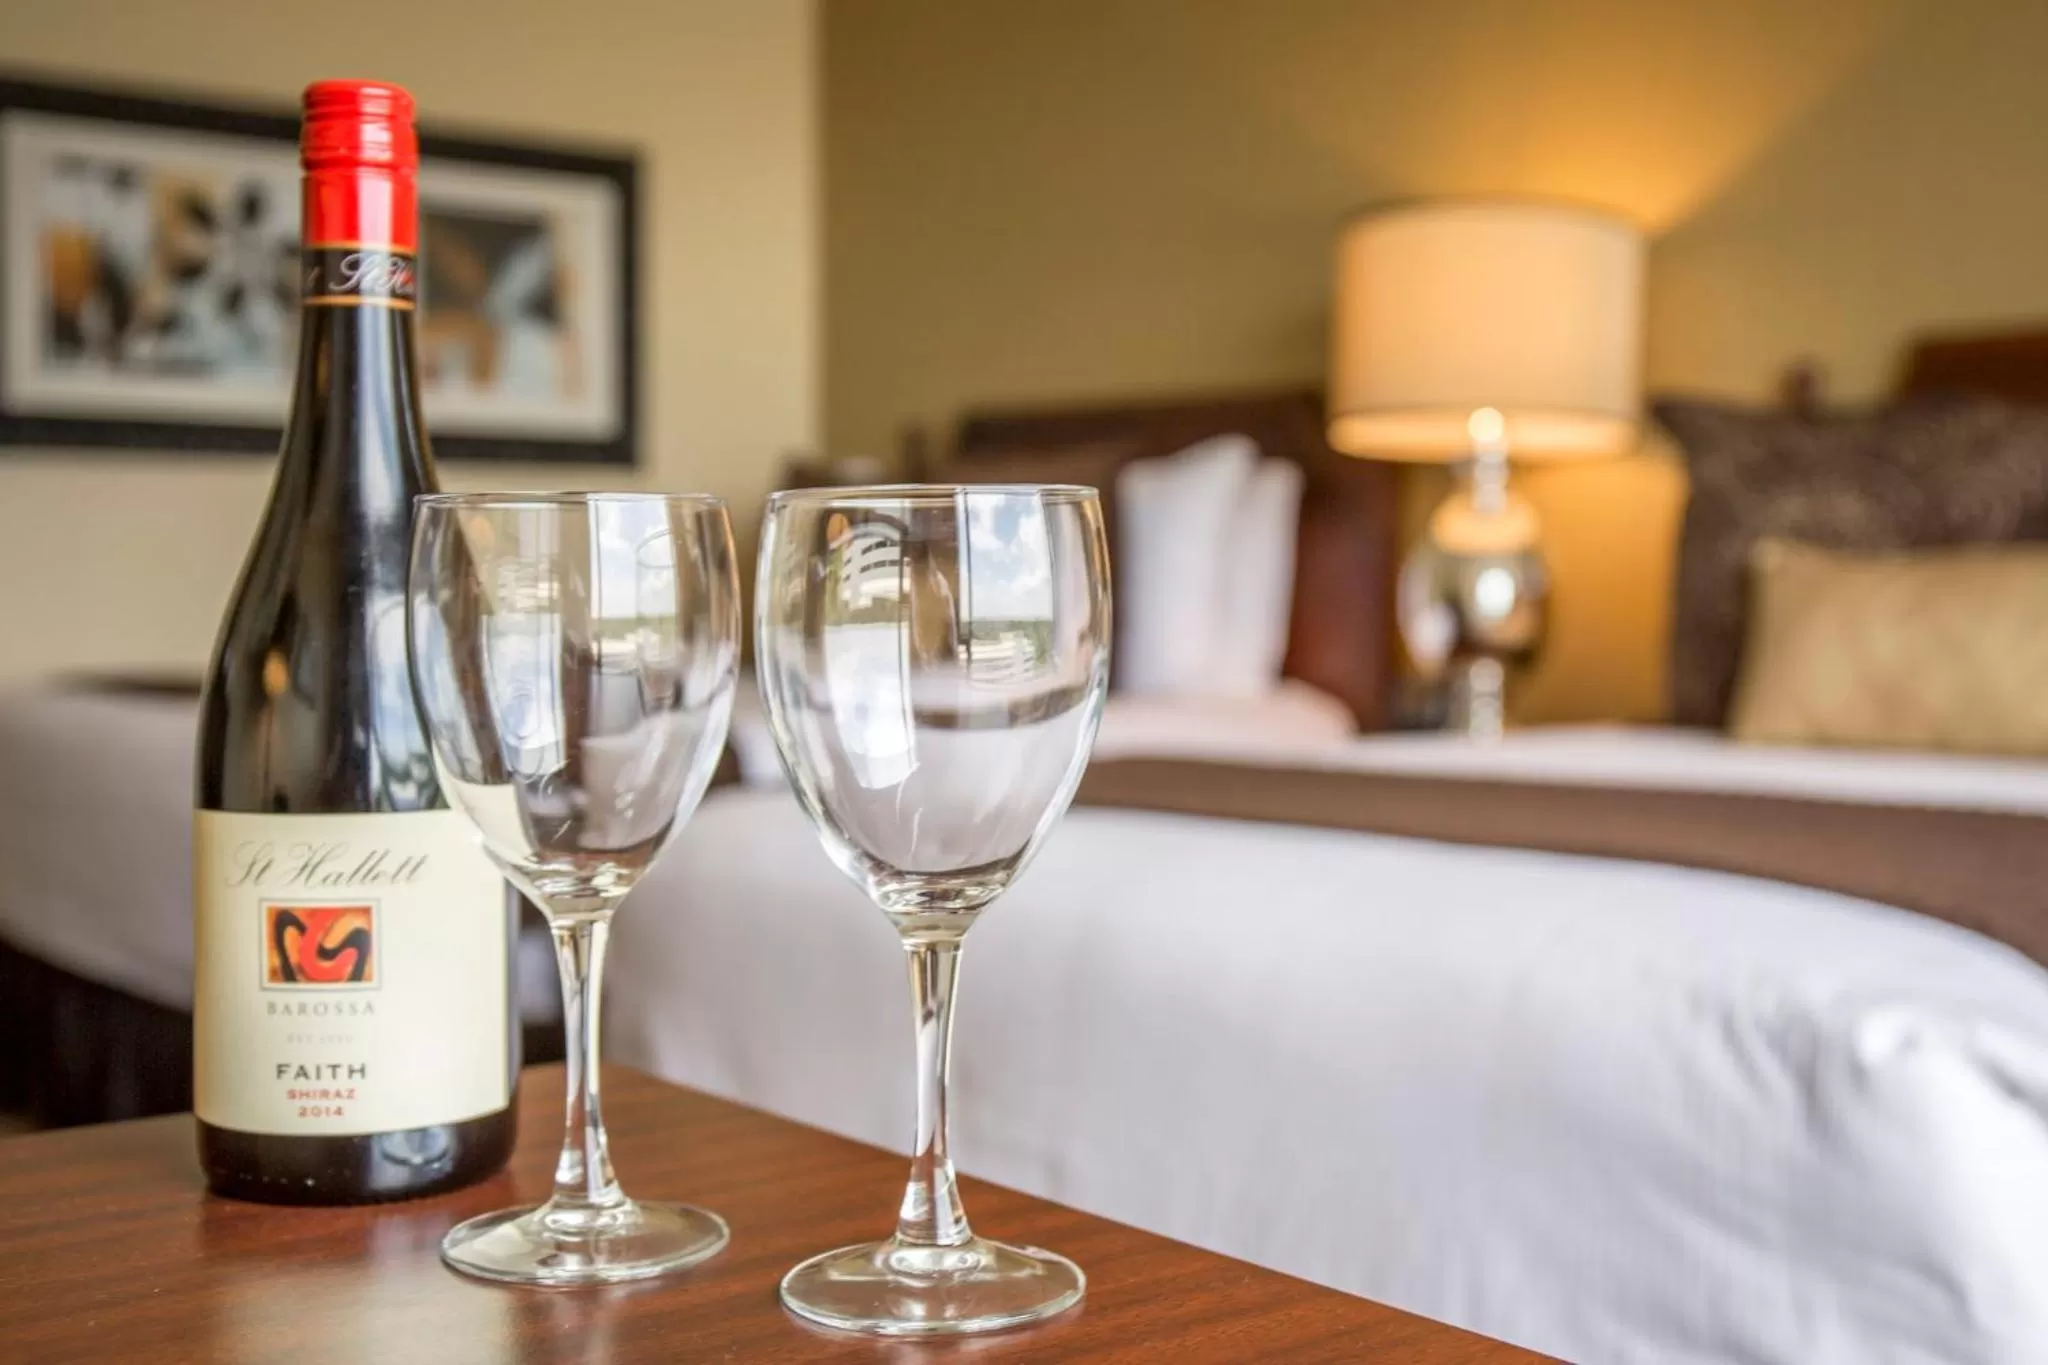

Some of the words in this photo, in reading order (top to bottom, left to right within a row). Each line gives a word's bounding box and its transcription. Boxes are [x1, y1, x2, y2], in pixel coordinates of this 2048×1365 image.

[225, 840, 274, 887] St
[278, 840, 430, 888] Hallett
[266, 1000, 376, 1016] BAROSSA
[275, 1062, 367, 1081] FAITH
[286, 1087, 357, 1100] SHIRAZ
[297, 1105, 345, 1118] 2014
